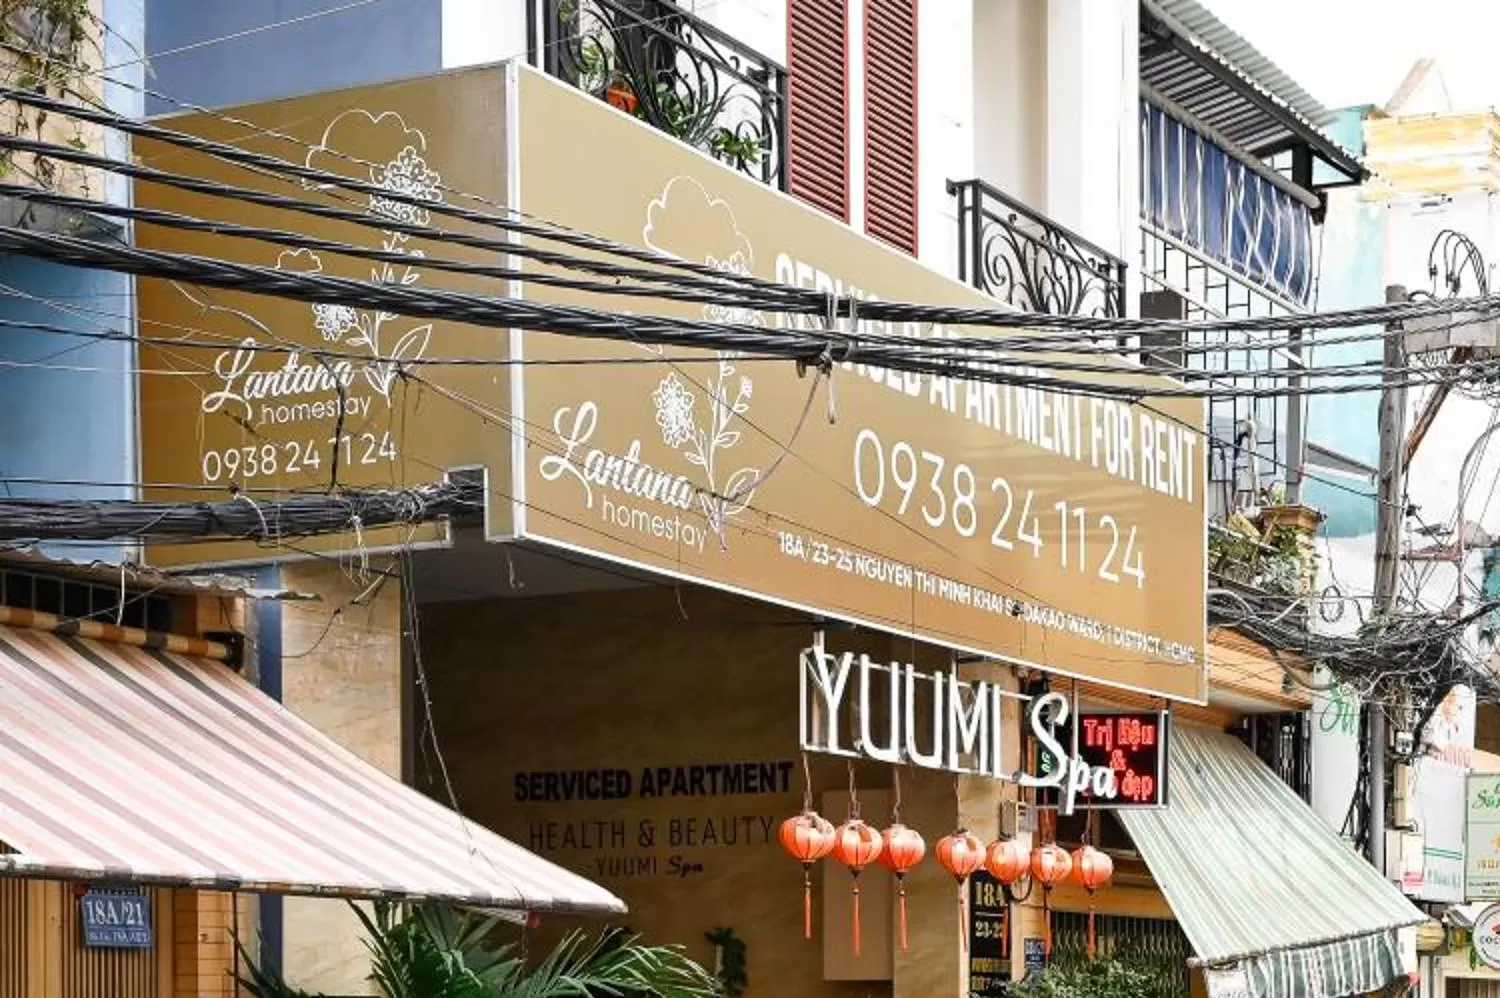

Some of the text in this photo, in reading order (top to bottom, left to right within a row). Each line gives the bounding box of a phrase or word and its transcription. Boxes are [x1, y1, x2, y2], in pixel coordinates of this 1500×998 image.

[202, 337, 355, 420] Lantana
[203, 432, 396, 481] 0938 24 1 24
[539, 401, 692, 510] Lantana
[1091, 398, 1135, 491] FOR
[1140, 413, 1197, 503] RENT
[602, 494, 706, 554] homestay
[854, 428, 1146, 589] 0938 24 11 24
[939, 578, 971, 605] MINH
[815, 645, 1117, 815] YUUMI Spa
[1084, 718, 1113, 752] Trị
[514, 761, 795, 801] SERVICED APARTMENT
[1110, 749, 1127, 771] &
[529, 815, 774, 850] HEALTH & BEAUTY
[596, 856, 657, 877] YUUMI
